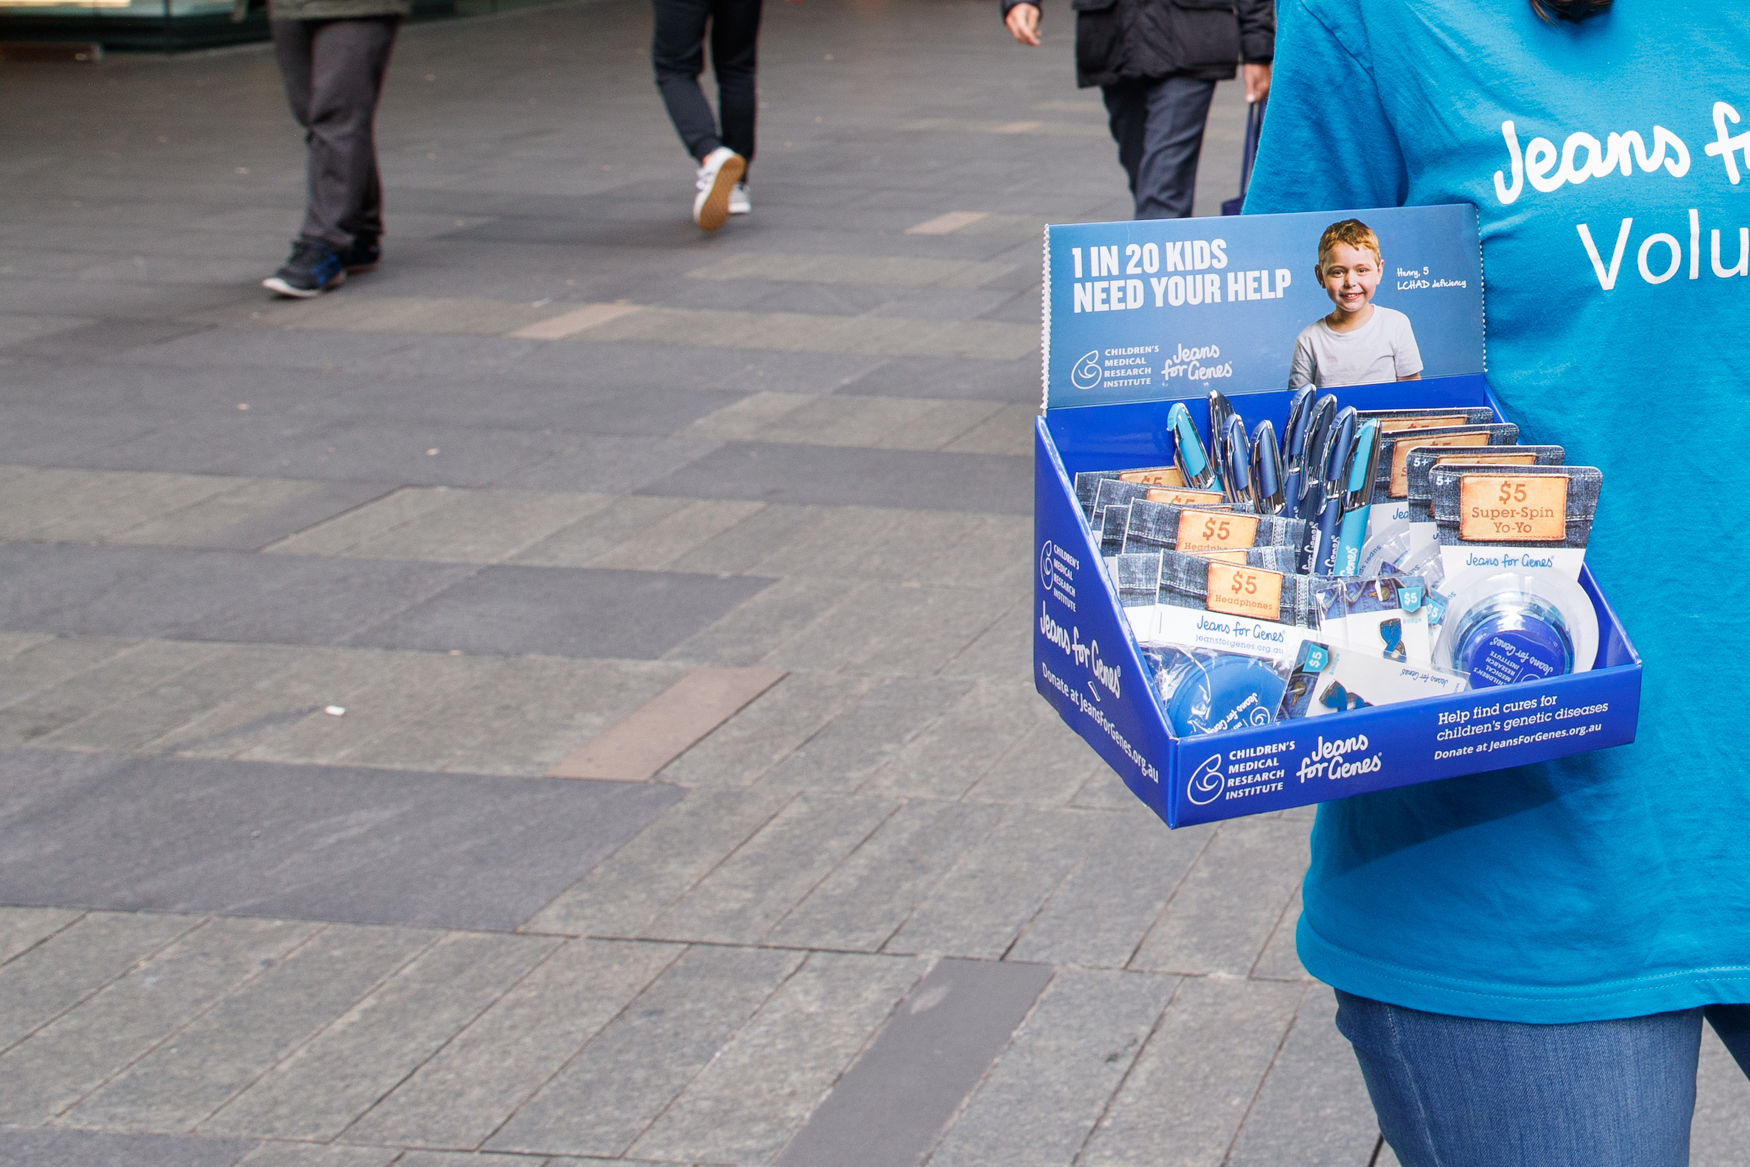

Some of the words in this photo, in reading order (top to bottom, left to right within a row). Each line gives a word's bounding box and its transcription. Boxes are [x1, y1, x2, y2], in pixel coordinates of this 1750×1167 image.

[1493, 120, 1691, 205] Jeans
[1071, 247, 1083, 278] 1
[1090, 245, 1119, 277] IN
[1125, 242, 1160, 275] 20
[1165, 238, 1228, 272] KIDS
[1423, 267, 1429, 276] 5
[1073, 279, 1144, 313] NEED
[1150, 273, 1222, 308] YOUR
[1227, 268, 1291, 302] HELP
[1397, 280, 1430, 291] LCHAD
[1432, 279, 1467, 289] deficiency
[1104, 345, 1160, 357] CHILDREN'S
[1172, 343, 1220, 364] Jeans
[1104, 357, 1146, 367] MEDICAL
[1161, 359, 1187, 381] for
[1103, 377, 1152, 388] INSTITUTE
[1104, 367, 1151, 378] RESEARCH
[1413, 458, 1428, 467] 5+
[1436, 476, 1452, 485] 5+
[1498, 481, 1527, 504] $5
[1392, 507, 1409, 520] Jea
[1472, 506, 1554, 520] Super-Spin
[1203, 517, 1230, 541] $5
[1494, 522, 1532, 534] Yo-Yo
[1053, 544, 1080, 570] CHILDREN'S
[1466, 553, 1499, 567] Jeans
[1501, 554, 1519, 568] for
[1053, 558, 1073, 581] MEDICAL
[1053, 573, 1076, 597] RESEARCH
[1231, 571, 1258, 594] $5
[1053, 587, 1077, 612] INSTITUTE
[1215, 594, 1273, 611] Headphones
[1403, 592, 1418, 605] $5
[1040, 600, 1071, 656] Jeans
[1072, 625, 1090, 669] for
[1197, 615, 1230, 634] Jeans
[1233, 622, 1251, 637] for
[1309, 651, 1323, 668] $5
[1529, 656, 1554, 676] Jeans
[1438, 707, 1470, 725] Help
[1473, 703, 1500, 719] find
[1503, 698, 1537, 713] cures
[1540, 695, 1558, 708] for
[1042, 662, 1069, 697] Donate
[1070, 687, 1080, 705] at
[1080, 693, 1159, 784] JeansForGenes.org.au
[1437, 720, 1501, 741] children's
[1504, 711, 1553, 732] genetic
[1555, 702, 1609, 721] diseases
[1229, 741, 1296, 761] CHILDREN'S
[1311, 734, 1369, 762] Jeans
[1434, 745, 1474, 760] Donate
[1476, 740, 1488, 752] at
[1488, 723, 1602, 753] JeansForGenes.org.au
[1228, 757, 1280, 775] MEDICAL
[1296, 757, 1329, 784] for
[1227, 769, 1285, 787] RESEARCH
[1225, 782, 1284, 800] INSTITUTE
